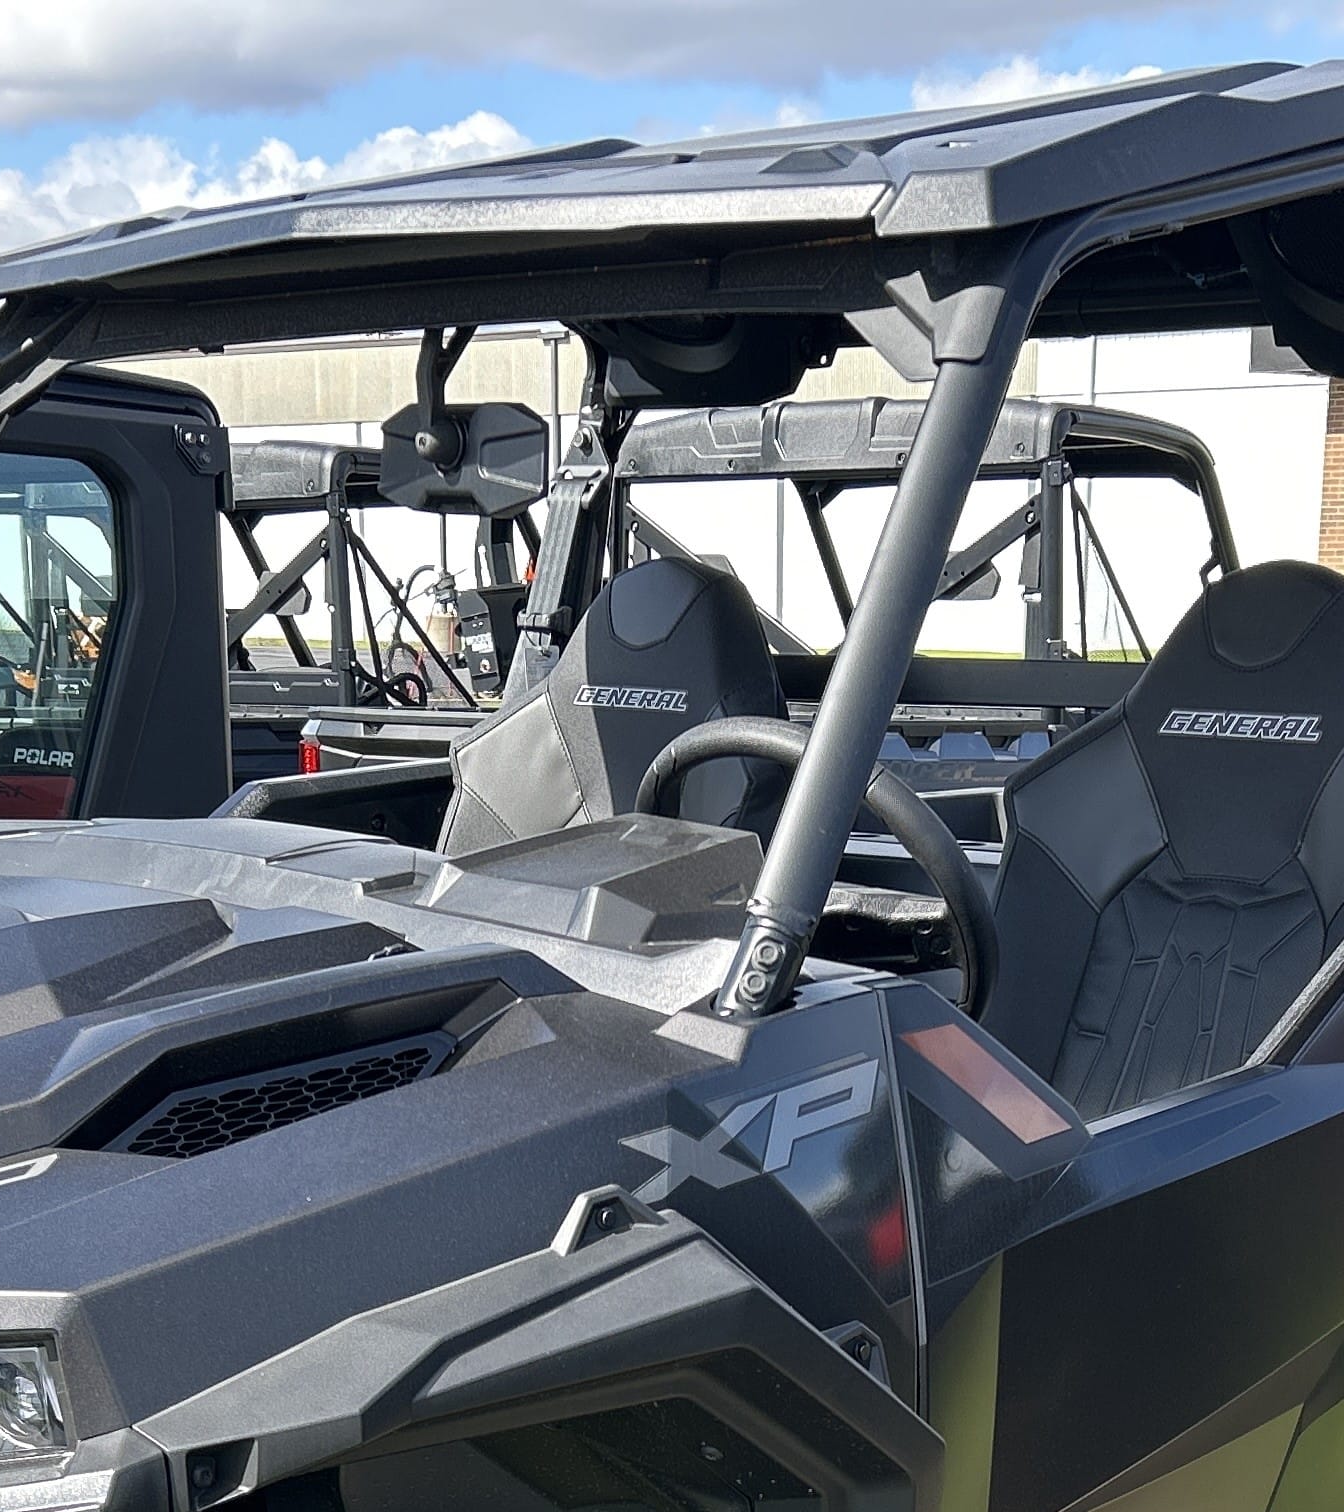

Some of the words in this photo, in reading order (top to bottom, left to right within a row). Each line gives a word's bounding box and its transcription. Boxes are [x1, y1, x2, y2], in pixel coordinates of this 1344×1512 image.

[573, 685, 687, 712] GENERAL
[1159, 710, 1323, 742] GENERAL
[617, 1057, 880, 1205] XP
